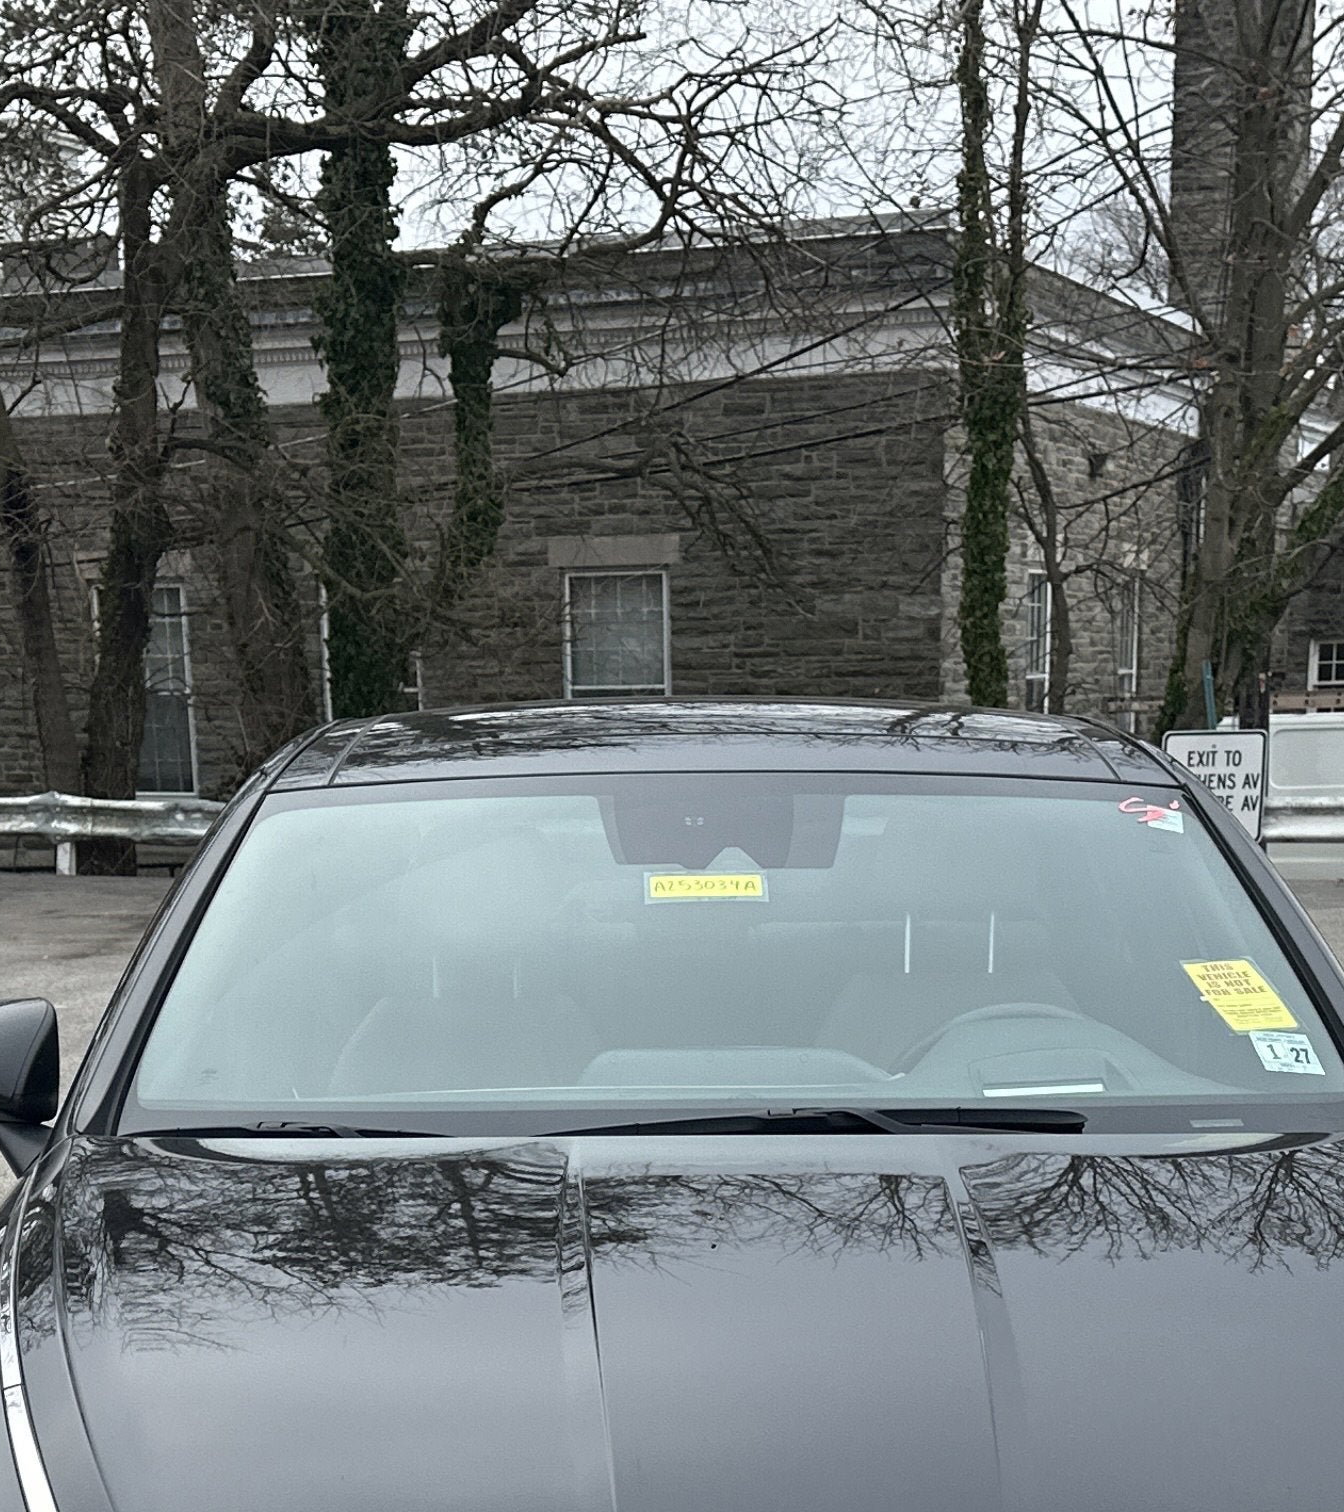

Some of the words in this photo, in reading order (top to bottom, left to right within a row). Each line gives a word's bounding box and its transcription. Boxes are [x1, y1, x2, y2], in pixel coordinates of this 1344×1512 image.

[1187, 750, 1218, 767] EXIT
[1224, 750, 1243, 767] TO
[1198, 773, 1236, 789] HENS
[1241, 773, 1260, 789] AV
[1241, 795, 1259, 811] AV
[1200, 963, 1234, 973] THIS
[1196, 970, 1252, 981] VEHICLE
[1206, 980, 1221, 989] IS
[1225, 978, 1252, 988] NOT
[1205, 988, 1232, 996] FOR
[1234, 985, 1268, 995] SALE
[1267, 1044, 1281, 1060] 1
[1290, 1047, 1311, 1064] 27
